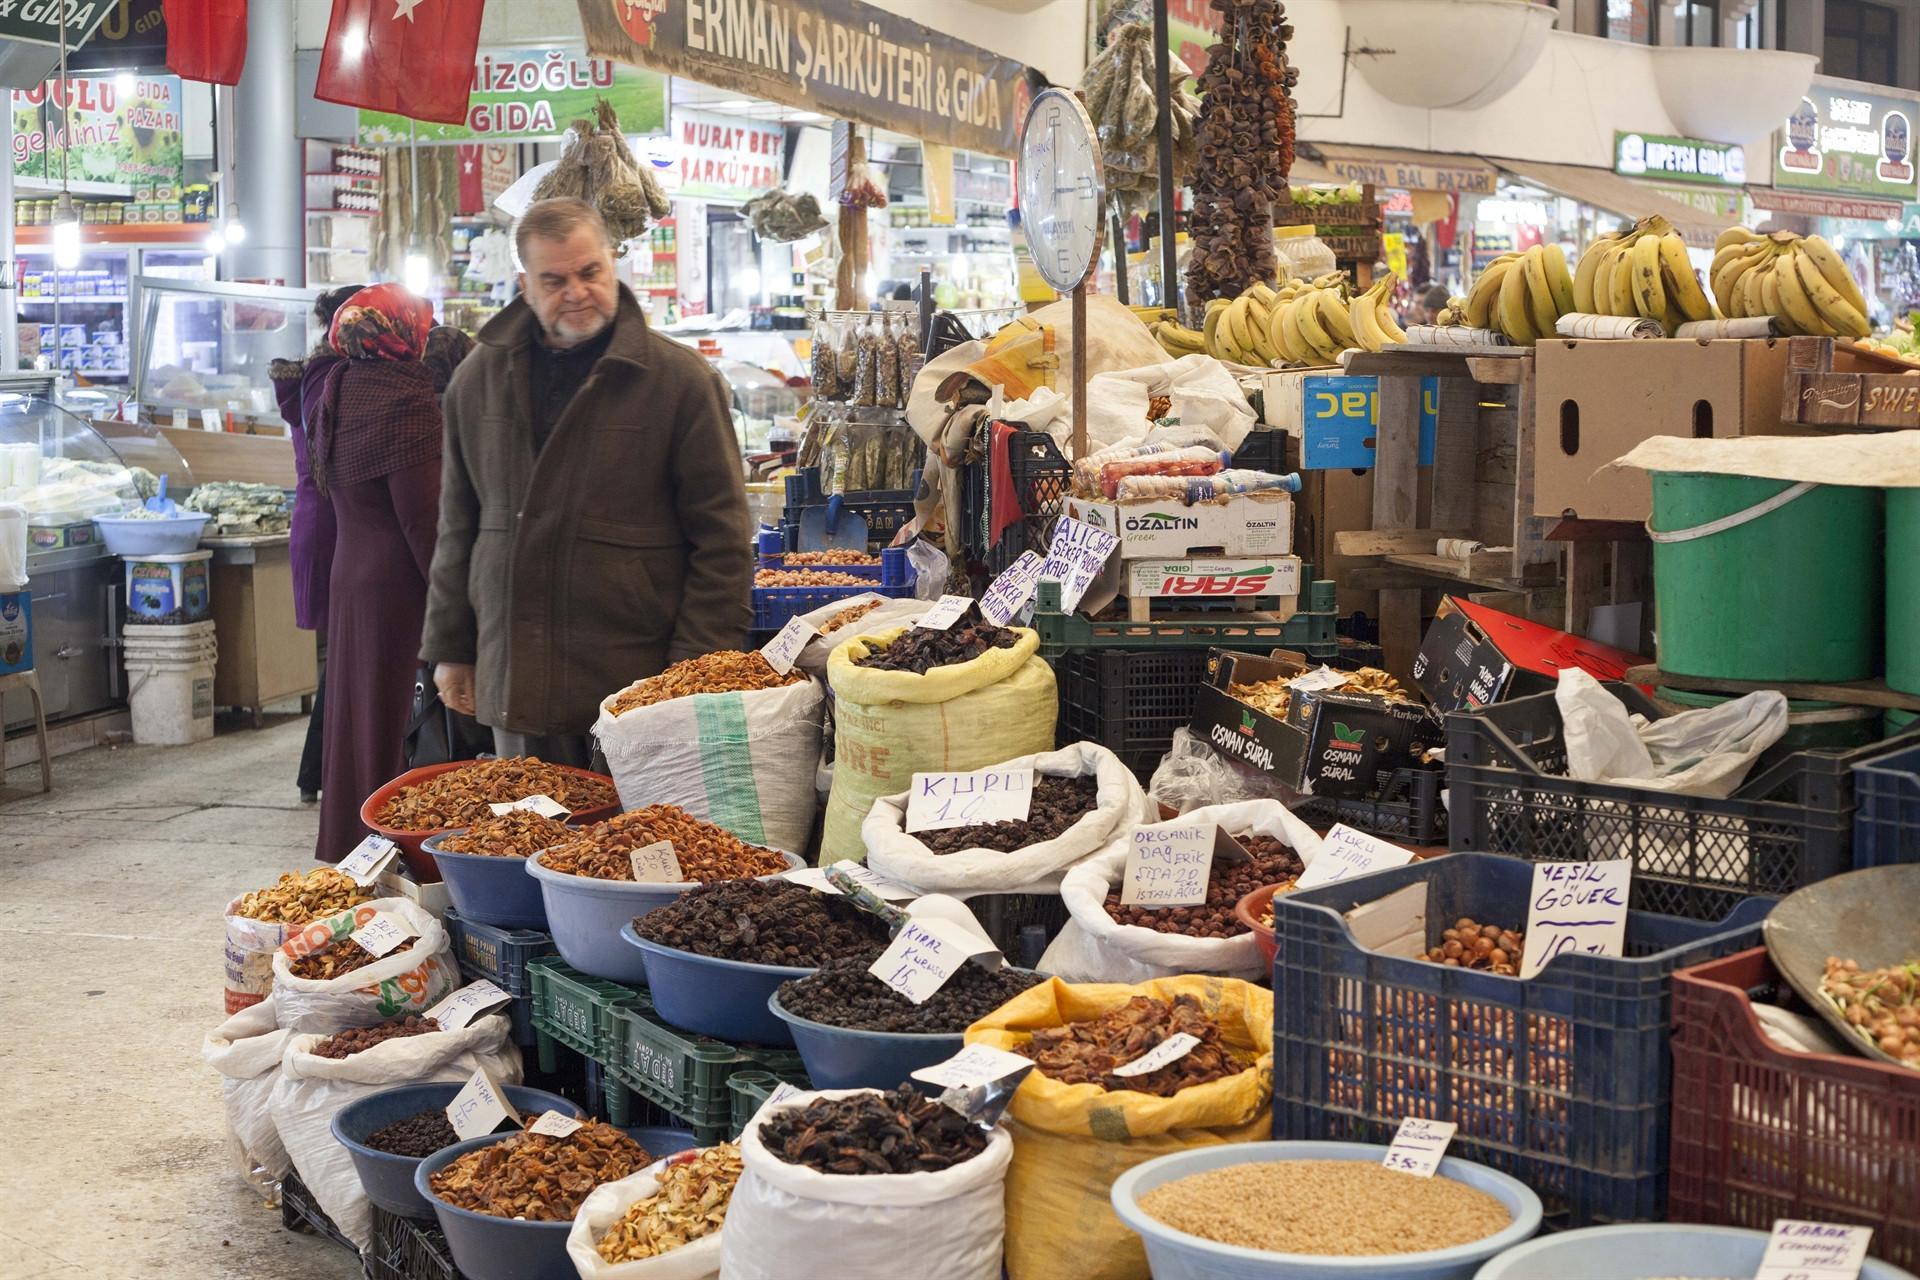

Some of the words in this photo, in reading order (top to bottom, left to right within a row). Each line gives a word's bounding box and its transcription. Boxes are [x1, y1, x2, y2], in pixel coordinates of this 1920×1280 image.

[19, 0, 95, 30] GIDA
[687, 0, 790, 74] ERMAN
[795, 11, 932, 113] ŞARKÜTERİ
[935, 66, 950, 118] &
[952, 67, 1002, 131] GIDA
[136, 80, 170, 101] GIDA
[127, 107, 179, 130] PAZARI
[469, 101, 555, 133] GIDA
[12, 118, 120, 162] geldiniz
[683, 121, 745, 151] MURAT
[750, 132, 783, 156] BEY
[1077, 176, 1094, 200] 3
[1334, 162, 1389, 186] KONYA
[1397, 168, 1426, 188] BAL
[1437, 171, 1490, 191] PAZARI
[1863, 387, 1920, 413] SWE
[1125, 516, 1199, 531] ÖZALTIN
[1246, 520, 1277, 528] ÖZALTIN
[1126, 533, 1157, 543] Green
[1164, 565, 1190, 573] GIDA
[1161, 576, 1273, 595] SARI
[1393, 709, 1424, 724] Turkey
[1211, 723, 1245, 755] OSMAN
[1244, 737, 1276, 771] SÜRAL
[1322, 749, 1363, 765] OSMAN
[1320, 763, 1356, 782] SÜRAL
[923, 773, 1024, 797] KURU
[1134, 826, 1206, 843] ORGANİK
[1332, 829, 1376, 854] KURU
[1542, 861, 1607, 889] YEŞİL
[1535, 884, 1624, 911] GÖVER
[902, 924, 943, 954] KIRAZ
